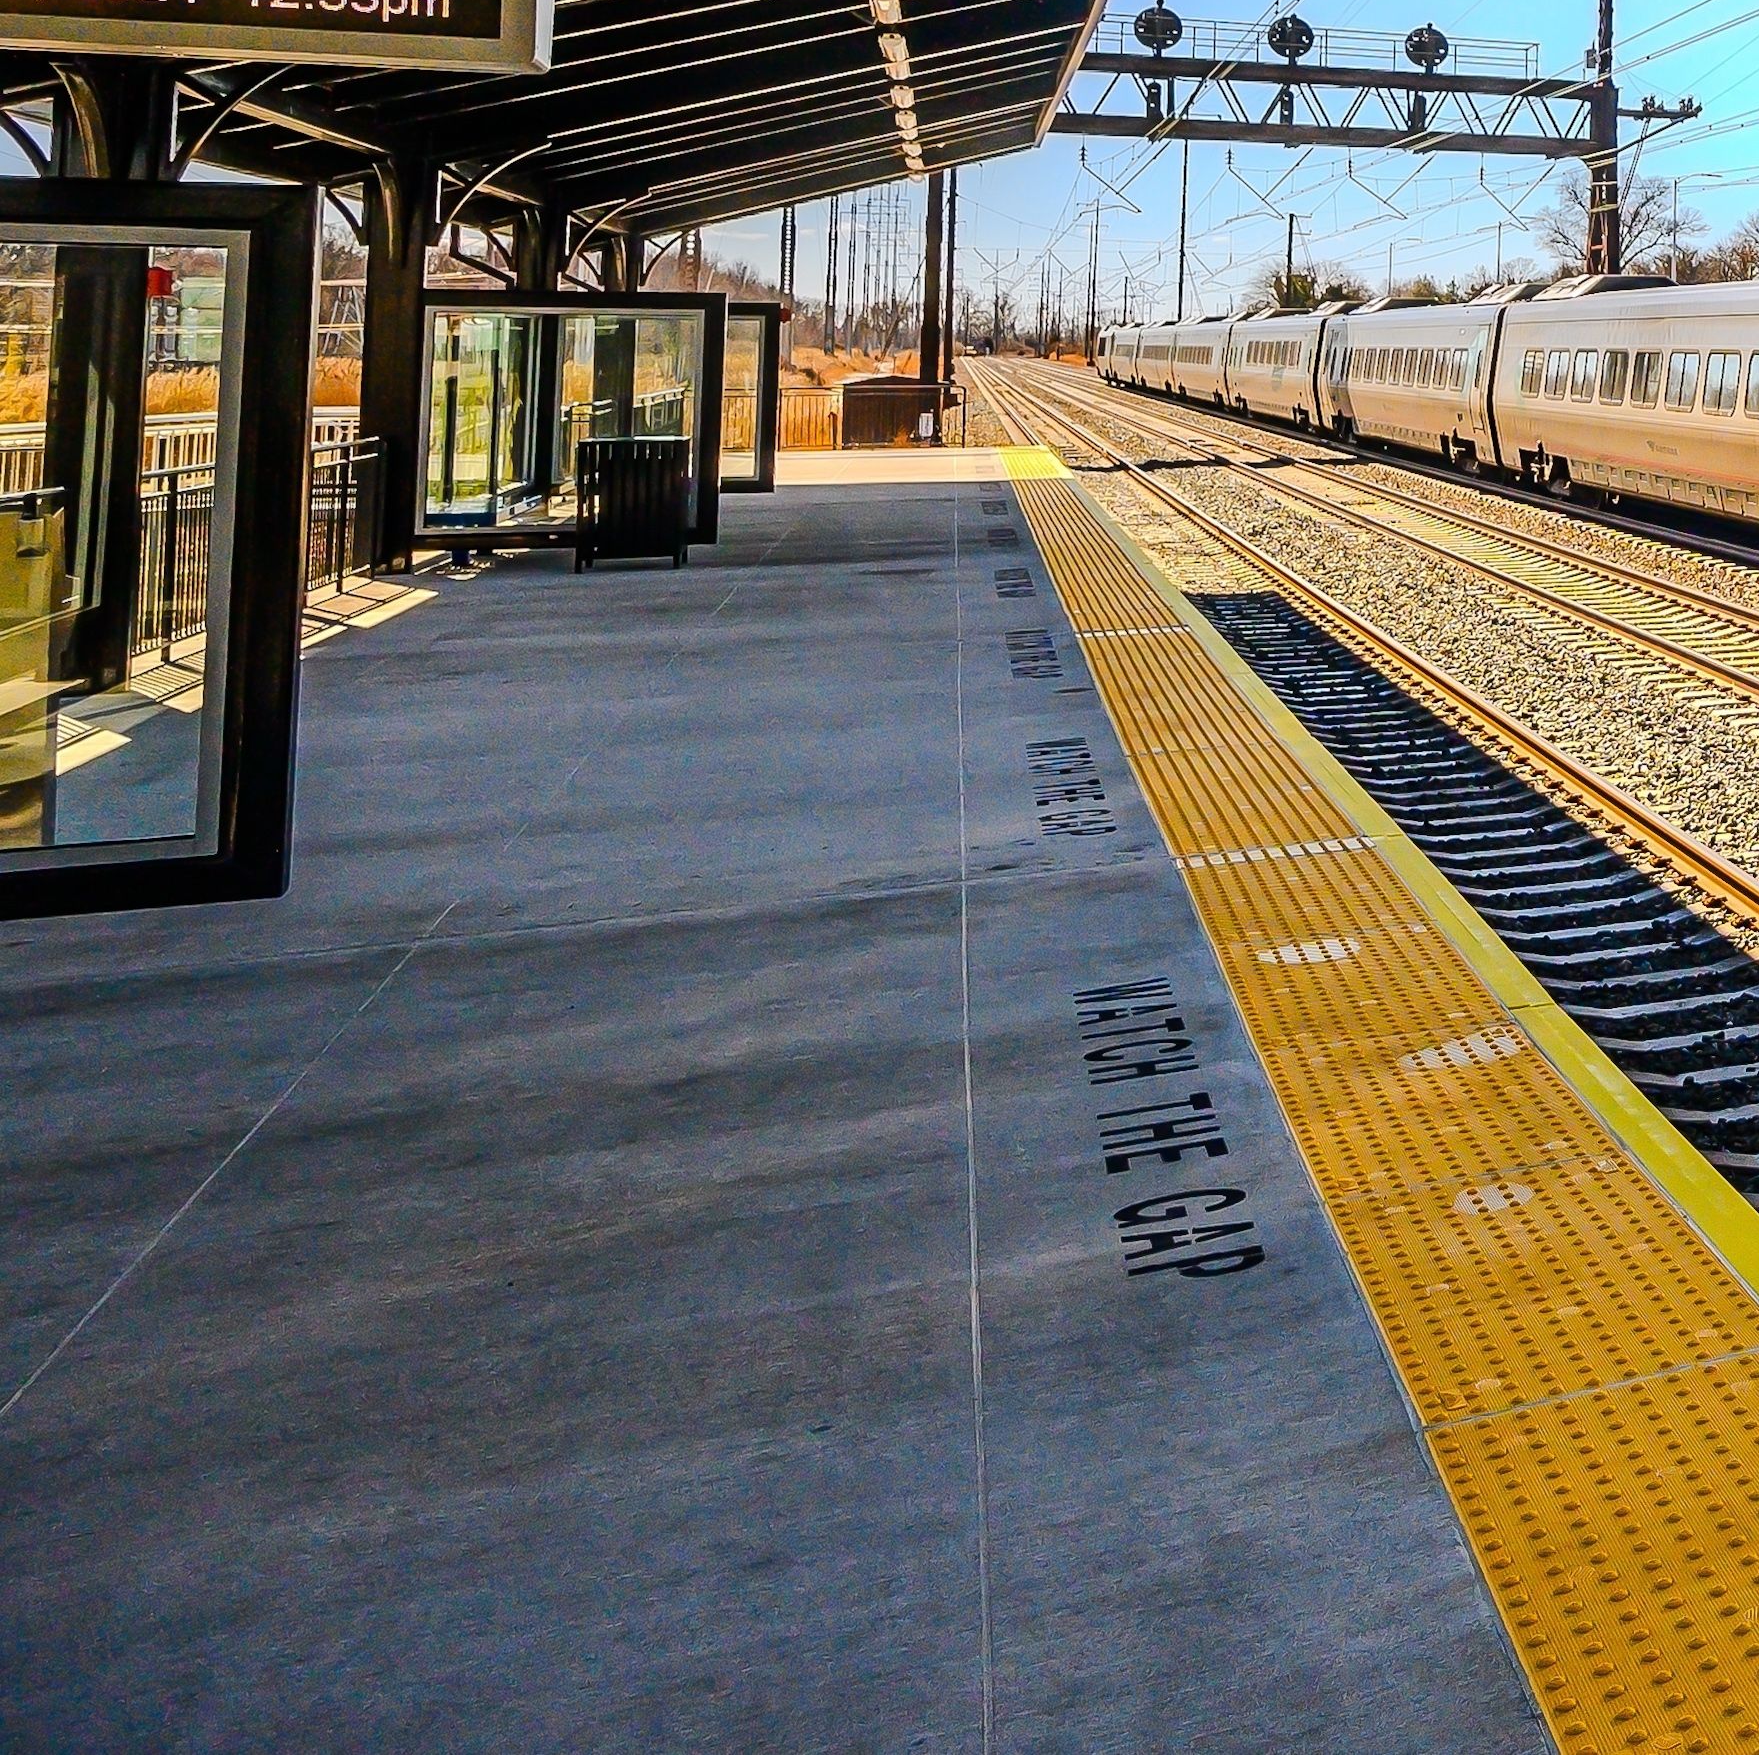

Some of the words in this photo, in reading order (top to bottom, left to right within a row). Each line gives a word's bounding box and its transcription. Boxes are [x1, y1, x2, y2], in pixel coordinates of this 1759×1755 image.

[1072, 977, 1200, 1086] WATCH
[1096, 1092, 1229, 1175] THE
[1113, 1188, 1266, 1278] GAP
